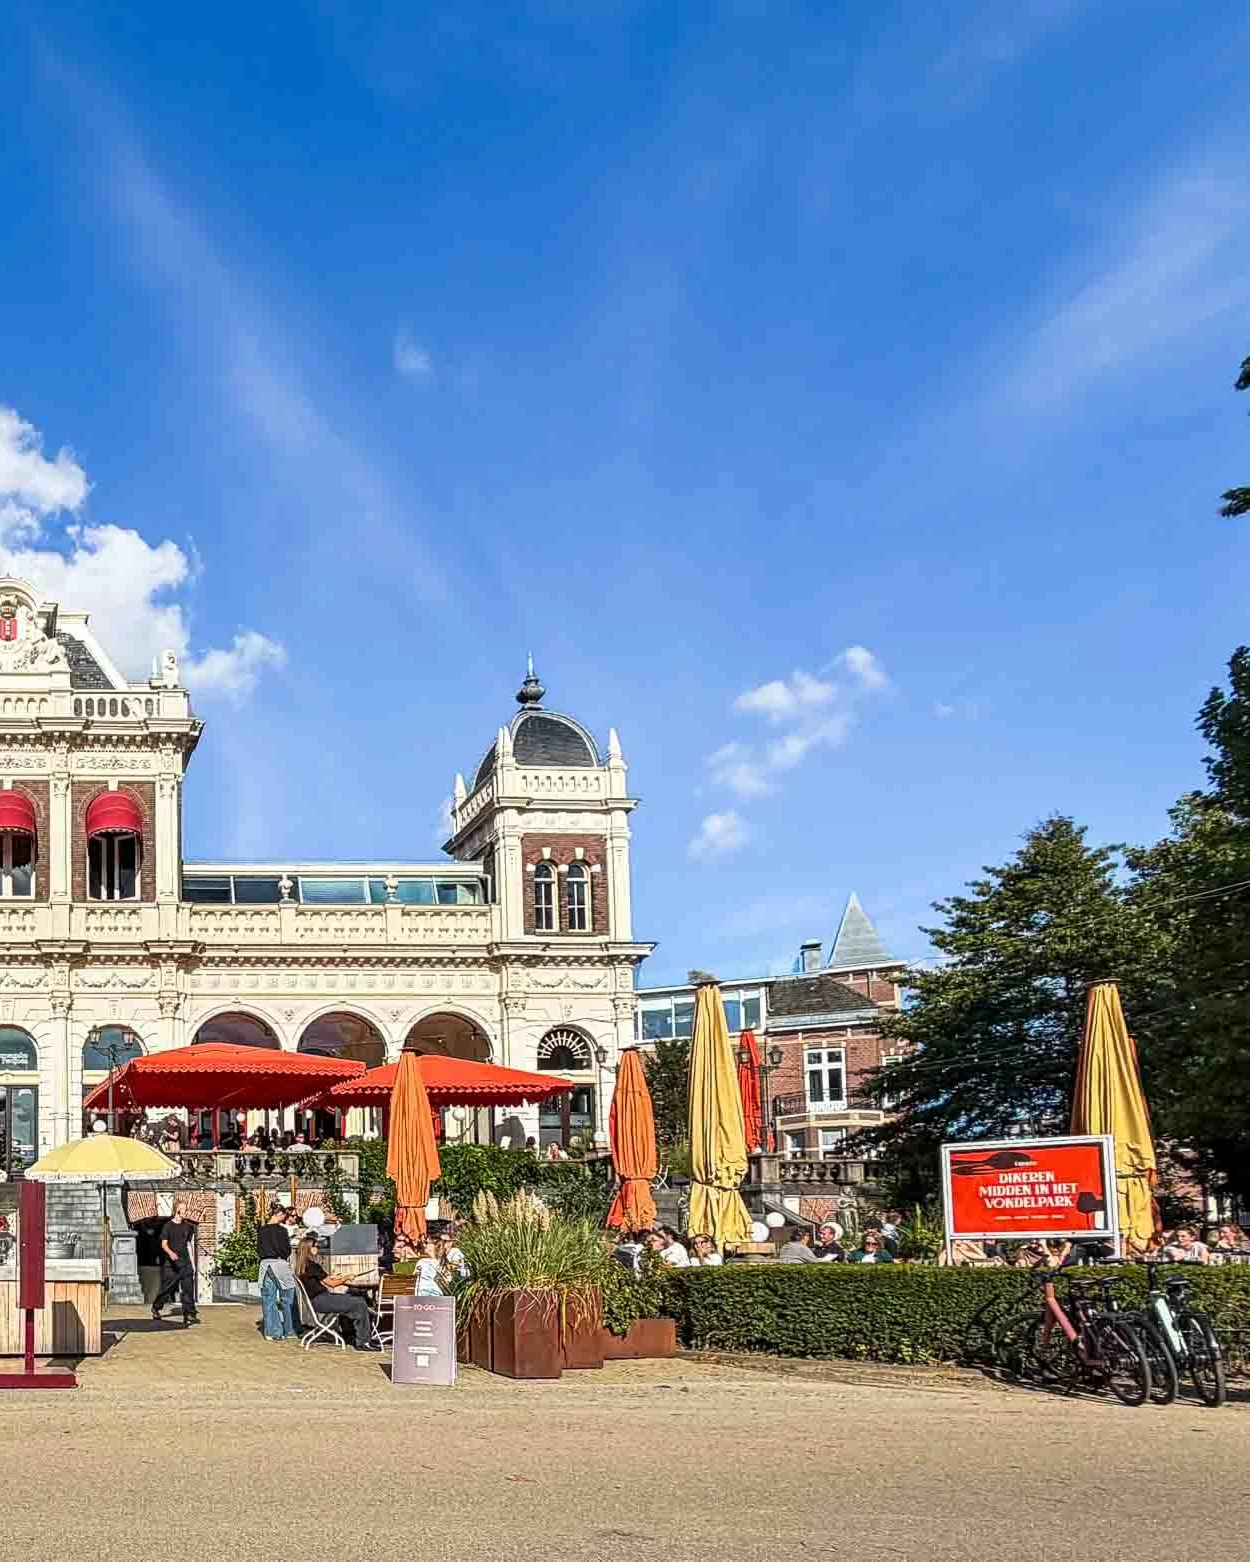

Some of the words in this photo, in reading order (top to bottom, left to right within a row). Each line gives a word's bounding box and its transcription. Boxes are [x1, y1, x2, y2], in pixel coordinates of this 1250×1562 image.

[999, 1171, 1055, 1184] DINEREN
[979, 1184, 1033, 1197] MIDDEN
[1034, 1184, 1049, 1195] IN
[1053, 1182, 1079, 1194] HET
[984, 1195, 1074, 1209] VONDELPARK
